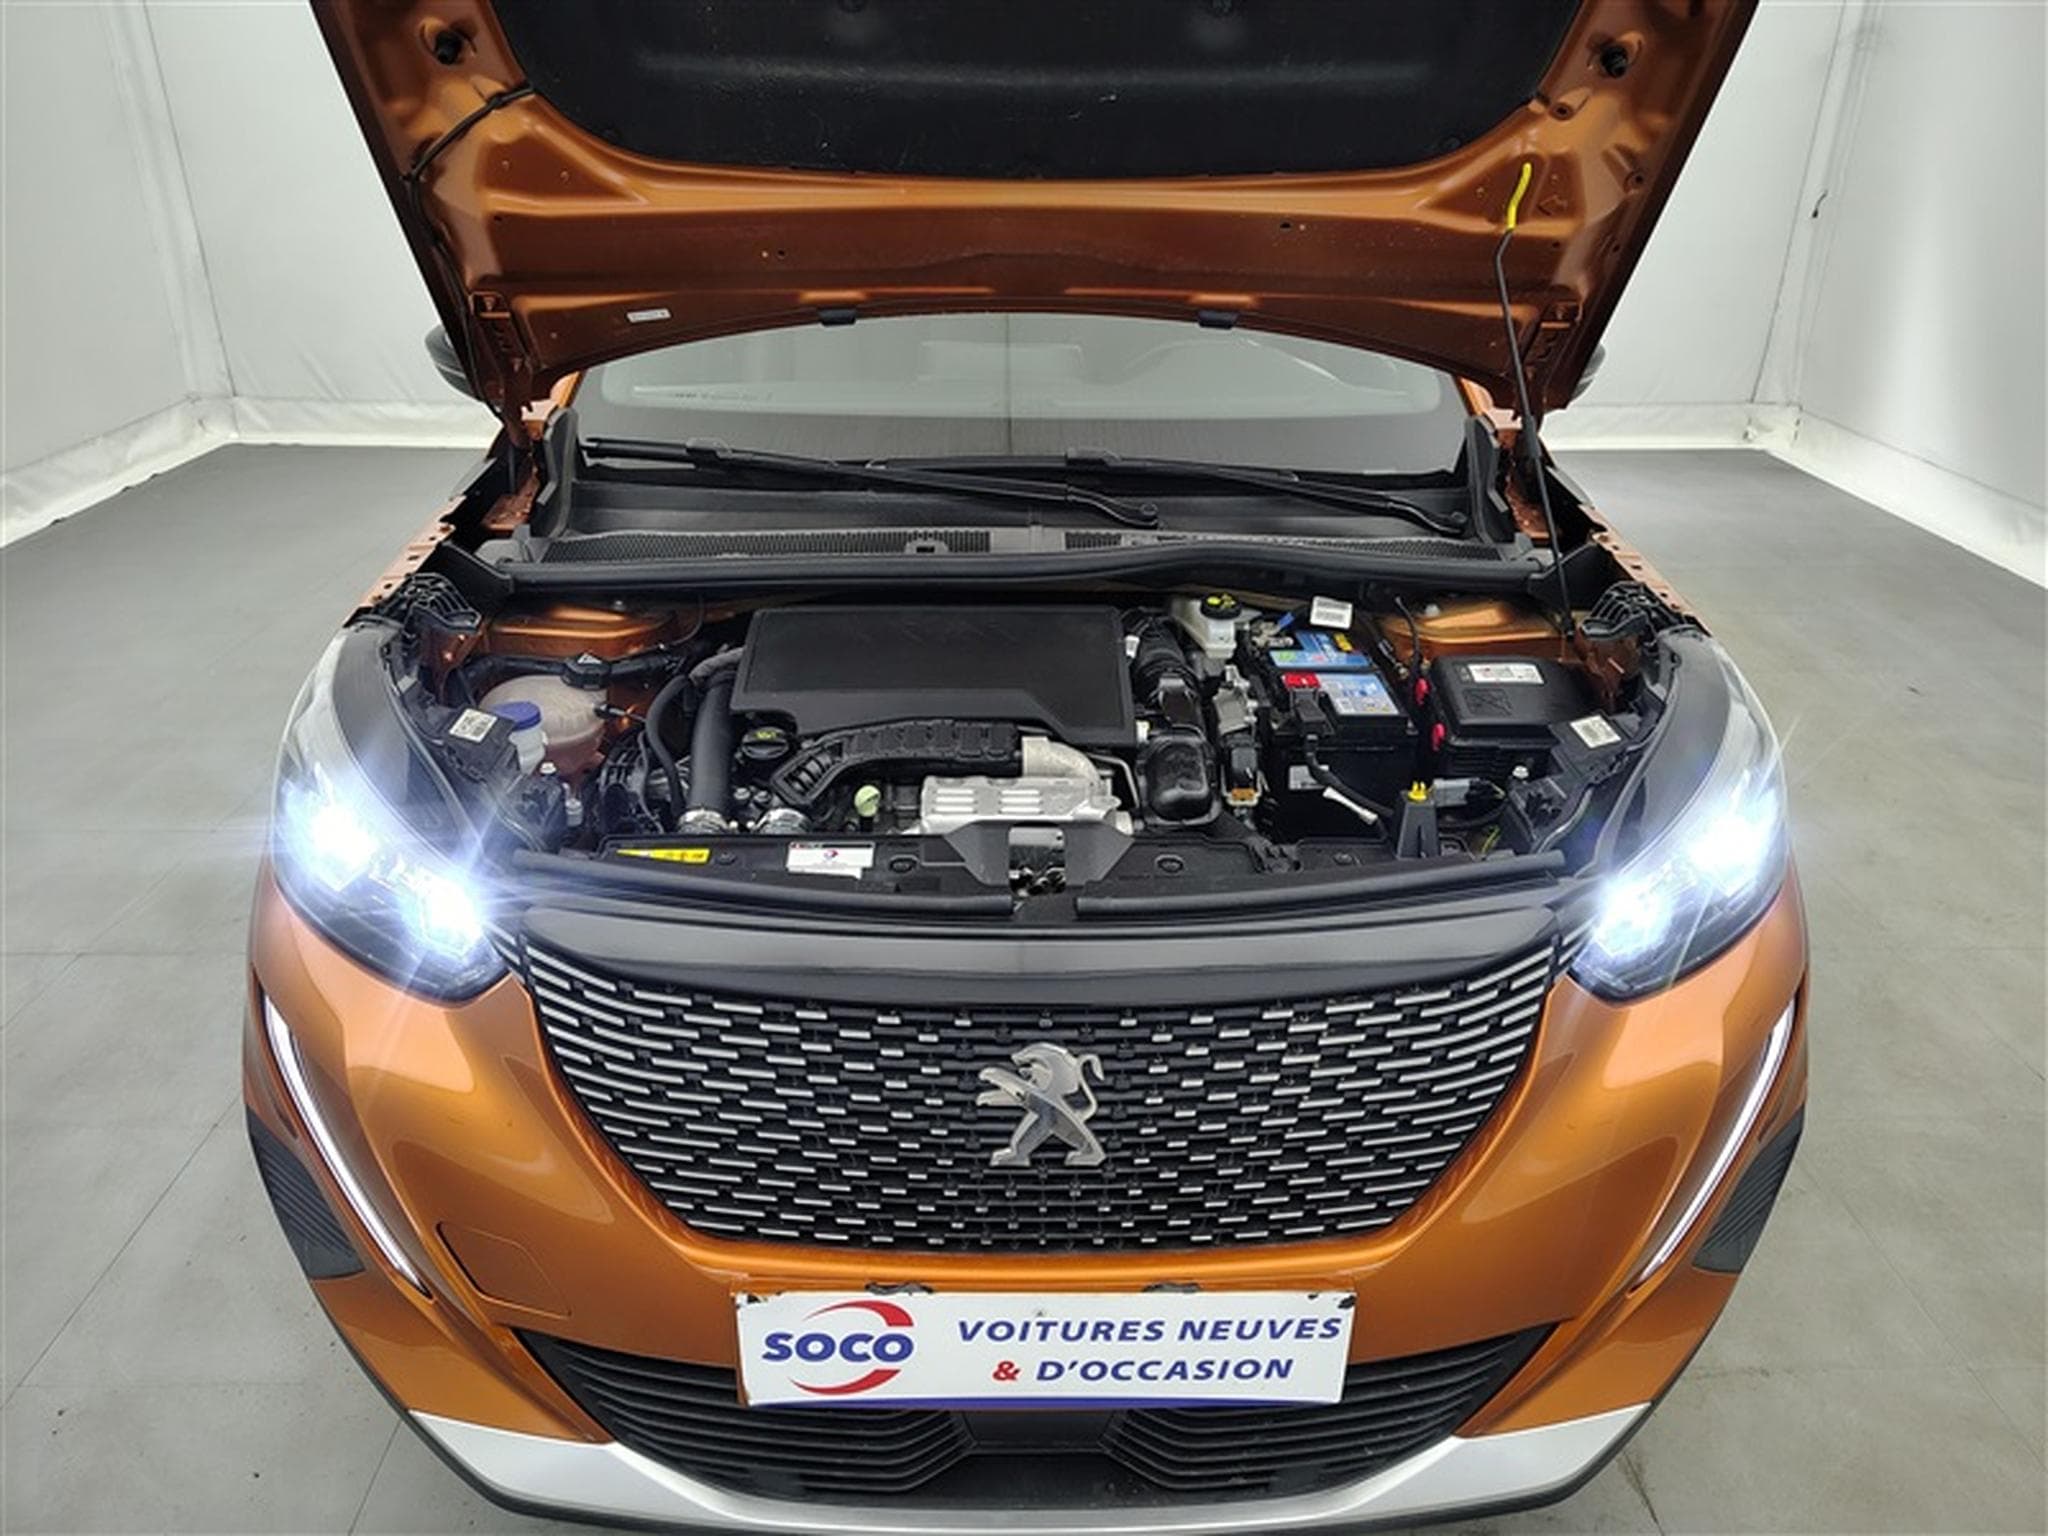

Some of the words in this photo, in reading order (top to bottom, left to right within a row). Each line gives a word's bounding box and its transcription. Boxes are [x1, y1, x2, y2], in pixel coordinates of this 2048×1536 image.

[958, 1319, 1166, 1342] VOITURES
[1177, 1317, 1342, 1340] NEUVES
[761, 1332, 915, 1363] SOCO
[992, 1360, 1021, 1382] &
[1036, 1358, 1294, 1381] D'OCCASION
